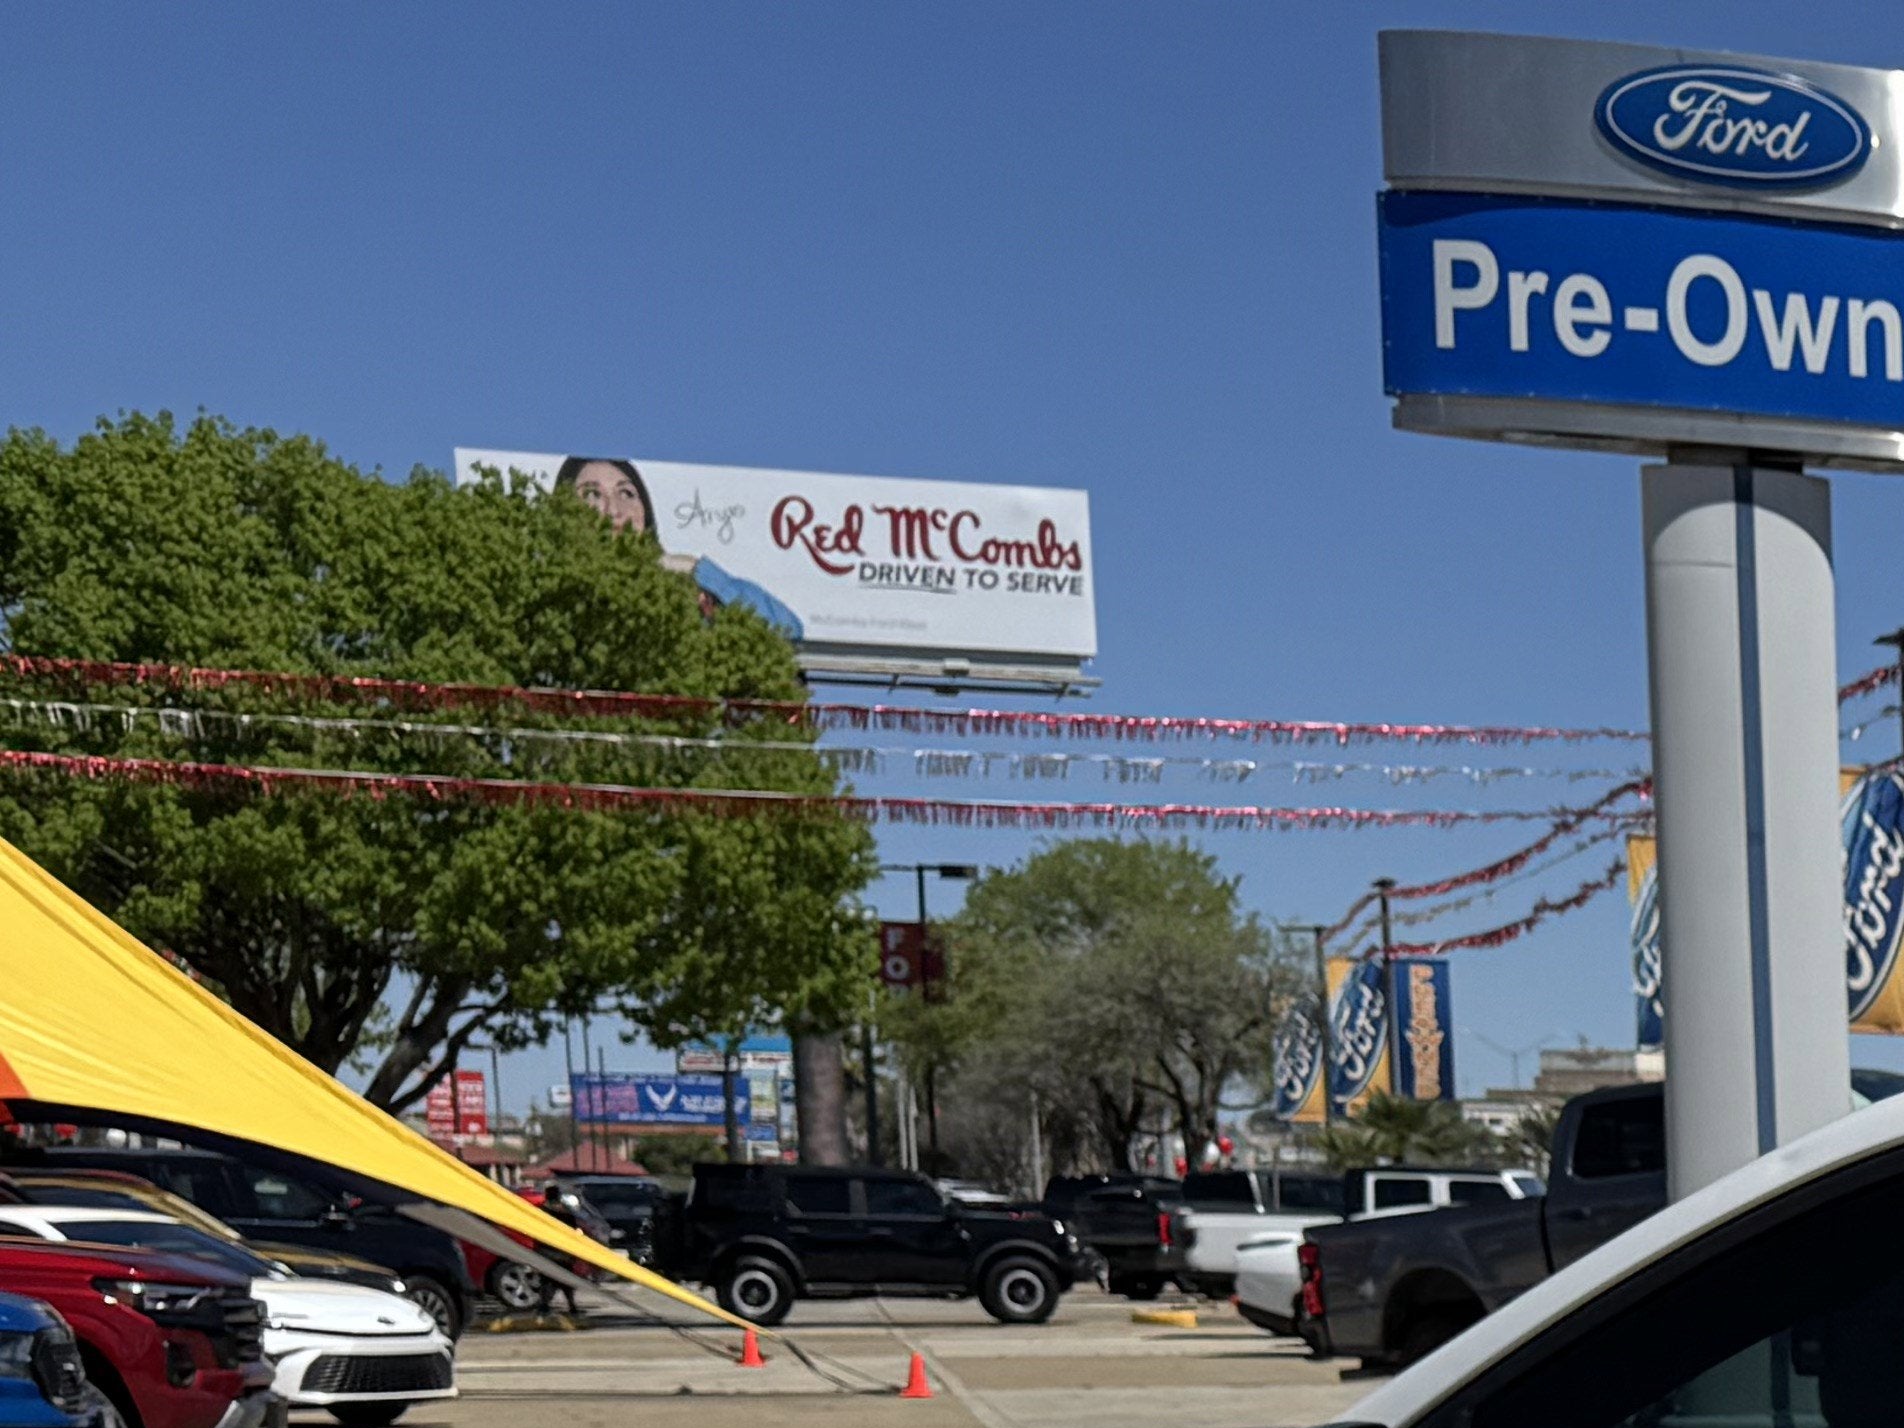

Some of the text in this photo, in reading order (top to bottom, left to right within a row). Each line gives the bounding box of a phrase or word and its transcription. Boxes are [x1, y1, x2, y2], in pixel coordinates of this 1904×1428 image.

[1653, 79, 1809, 163] Ford
[770, 494, 1083, 576] Red McCombs
[858, 561, 1083, 596] DRIVEN TO SERVE
[1330, 981, 1385, 1081] Ford
